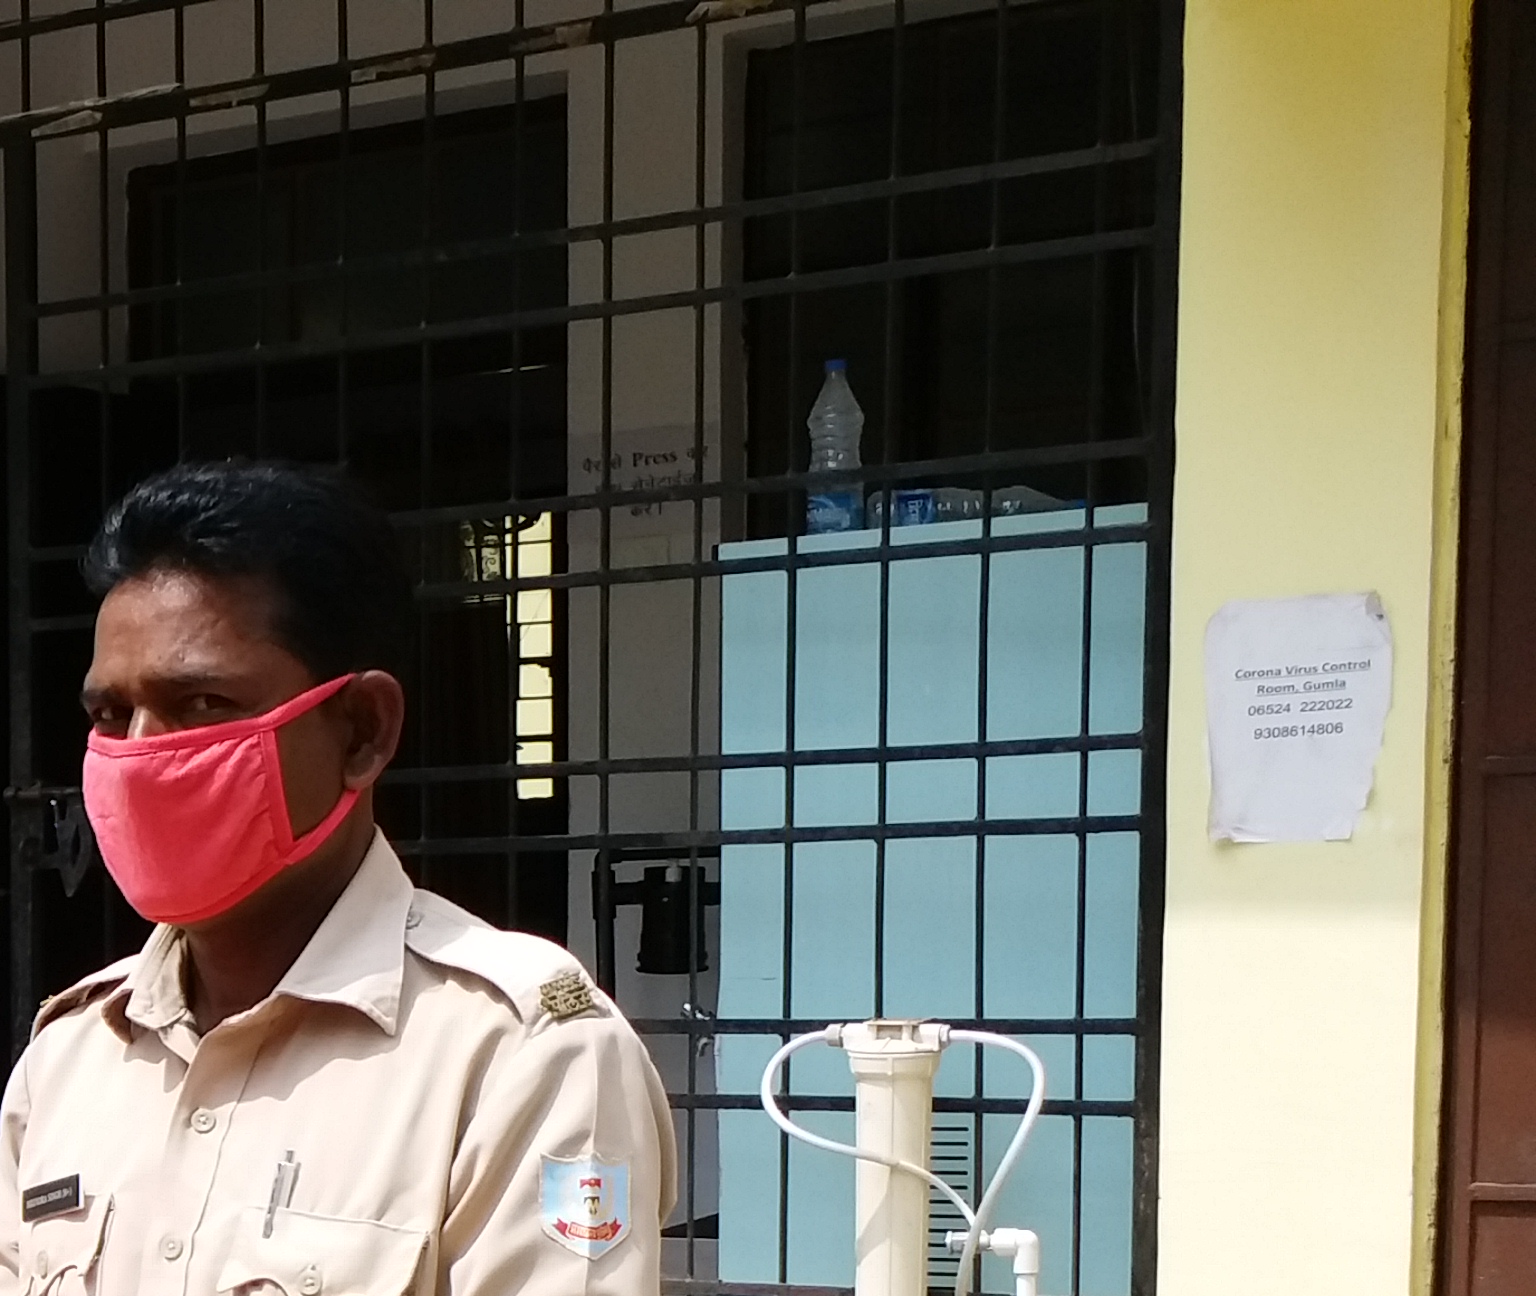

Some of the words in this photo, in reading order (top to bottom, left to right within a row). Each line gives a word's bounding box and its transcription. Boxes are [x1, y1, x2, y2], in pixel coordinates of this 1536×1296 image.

[633, 450, 679, 468] Press
[1234, 667, 1282, 680] Corona
[1286, 664, 1319, 677] Virus
[1322, 659, 1372, 673] Control
[1256, 683, 1299, 695] Room,
[1303, 678, 1347, 692] Gumla
[1248, 703, 1292, 717] 06524
[1299, 698, 1354, 713] 222022
[1253, 722, 1345, 740] 9308614806
